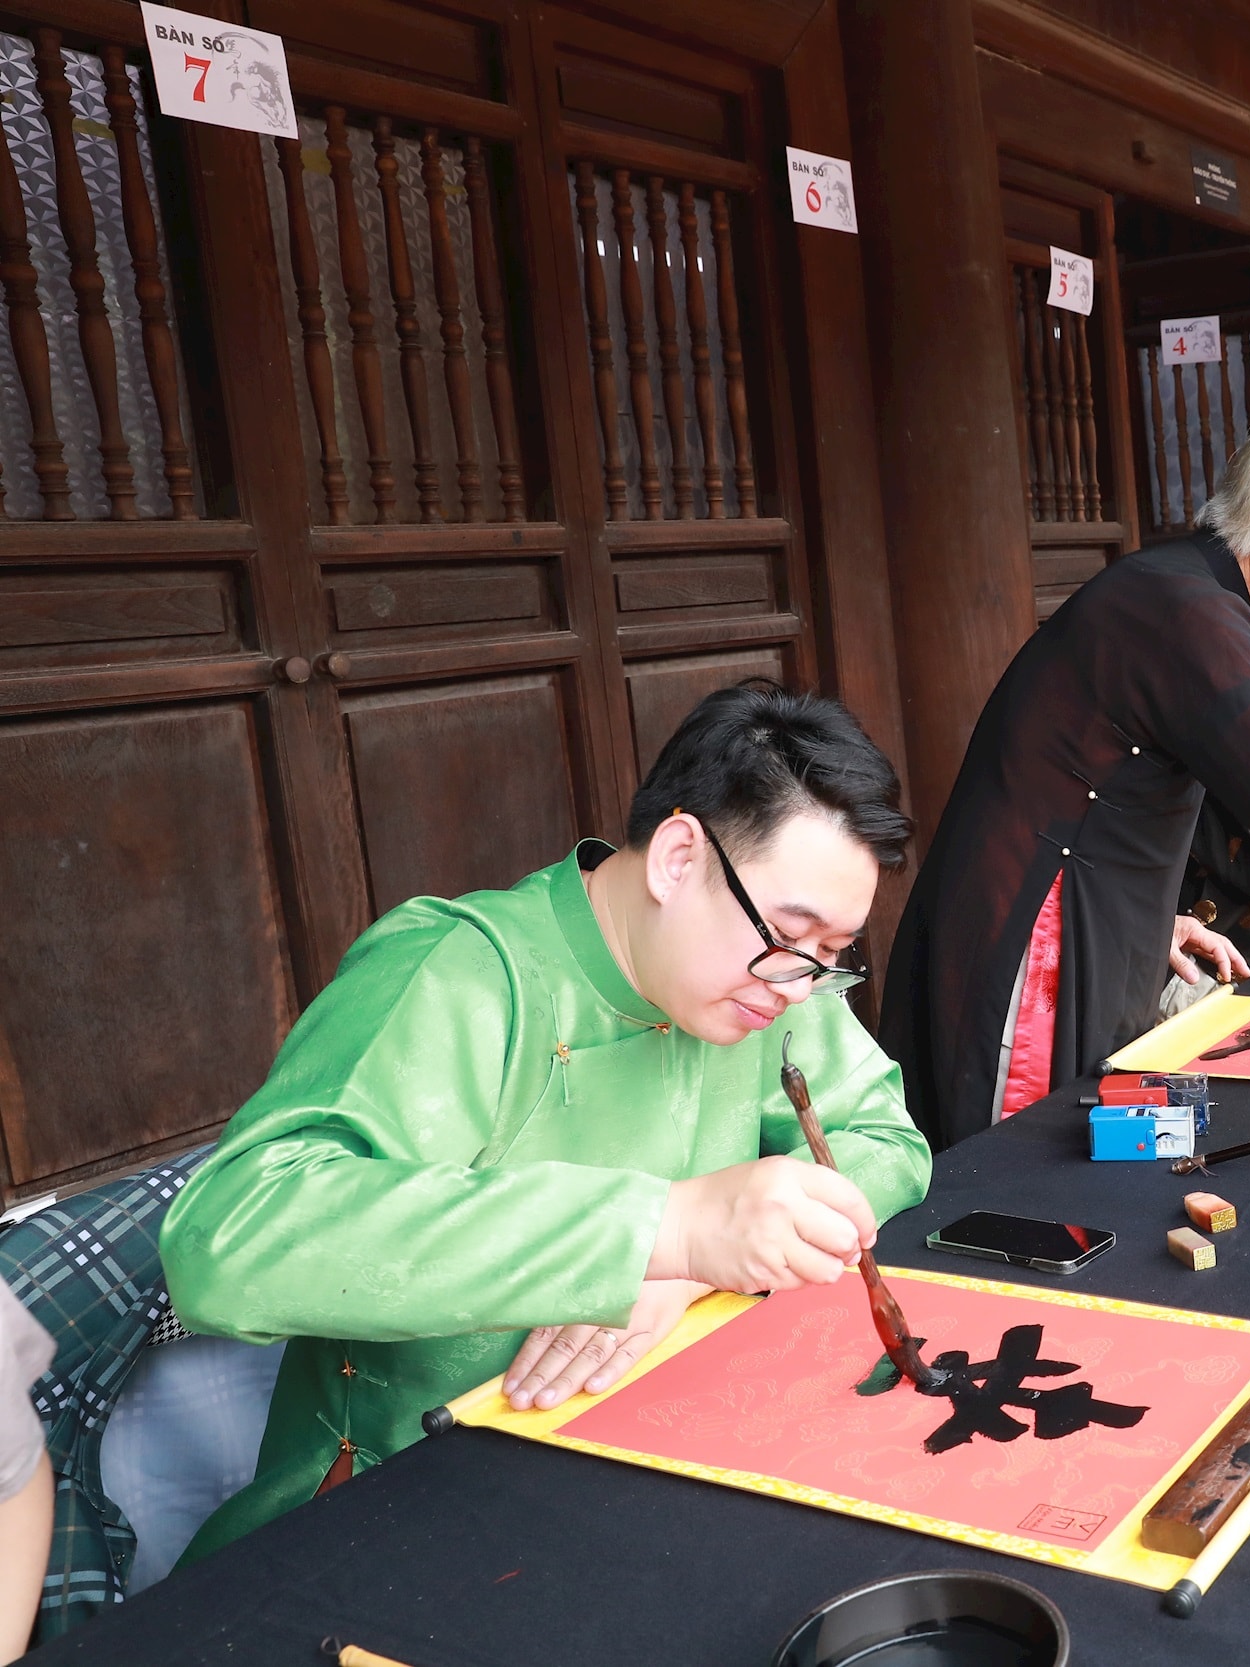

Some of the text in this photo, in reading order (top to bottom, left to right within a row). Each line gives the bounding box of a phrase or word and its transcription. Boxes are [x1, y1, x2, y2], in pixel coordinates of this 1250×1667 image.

[155, 24, 194, 46] BÀN
[184, 52, 211, 103] 7
[806, 181, 821, 213] 6
[1057, 272, 1068, 297] 5
[1173, 336, 1187, 355] 4
